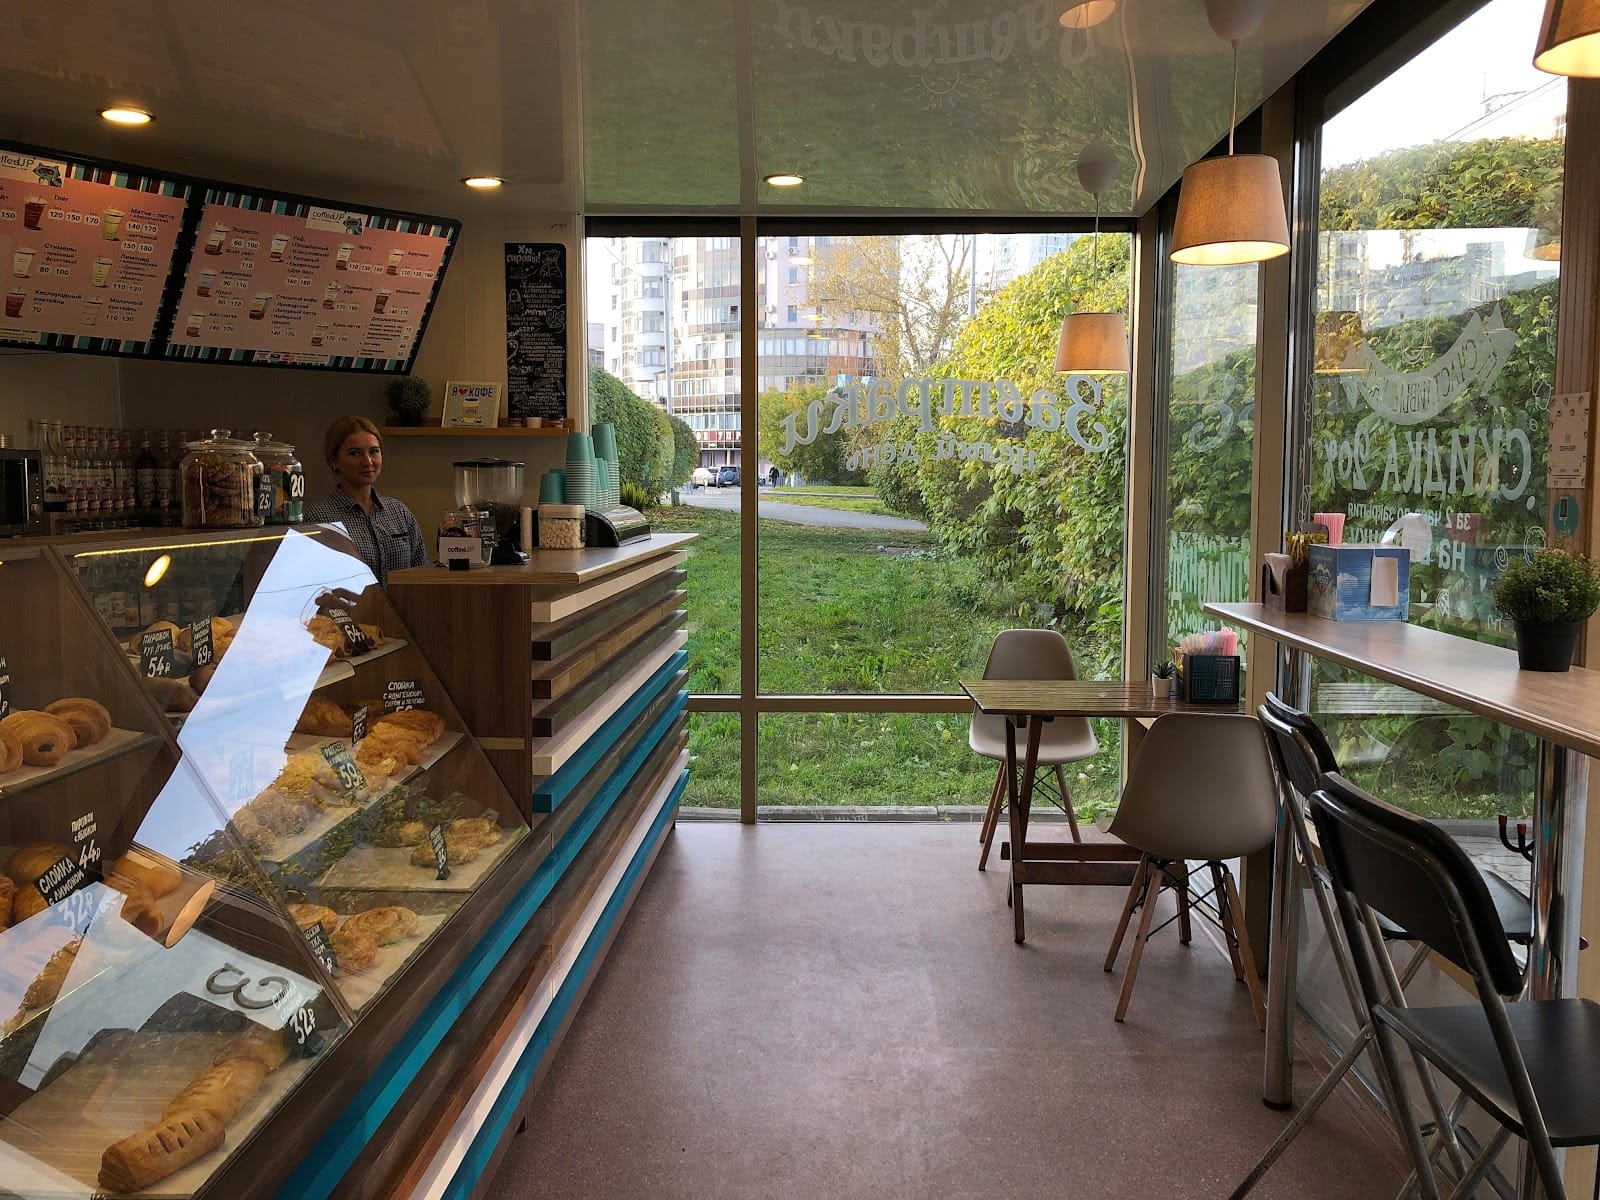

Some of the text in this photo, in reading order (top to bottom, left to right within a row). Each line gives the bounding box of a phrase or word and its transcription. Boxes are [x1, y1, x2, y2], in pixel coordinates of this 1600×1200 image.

[50, 211, 63, 219] 120
[452, 387, 493, 397] Я КОФЕ
[290, 474, 305, 497] 20
[39, 857, 76, 894] СЛОЙКА
[54, 869, 85, 902] ЛИМОНОМ
